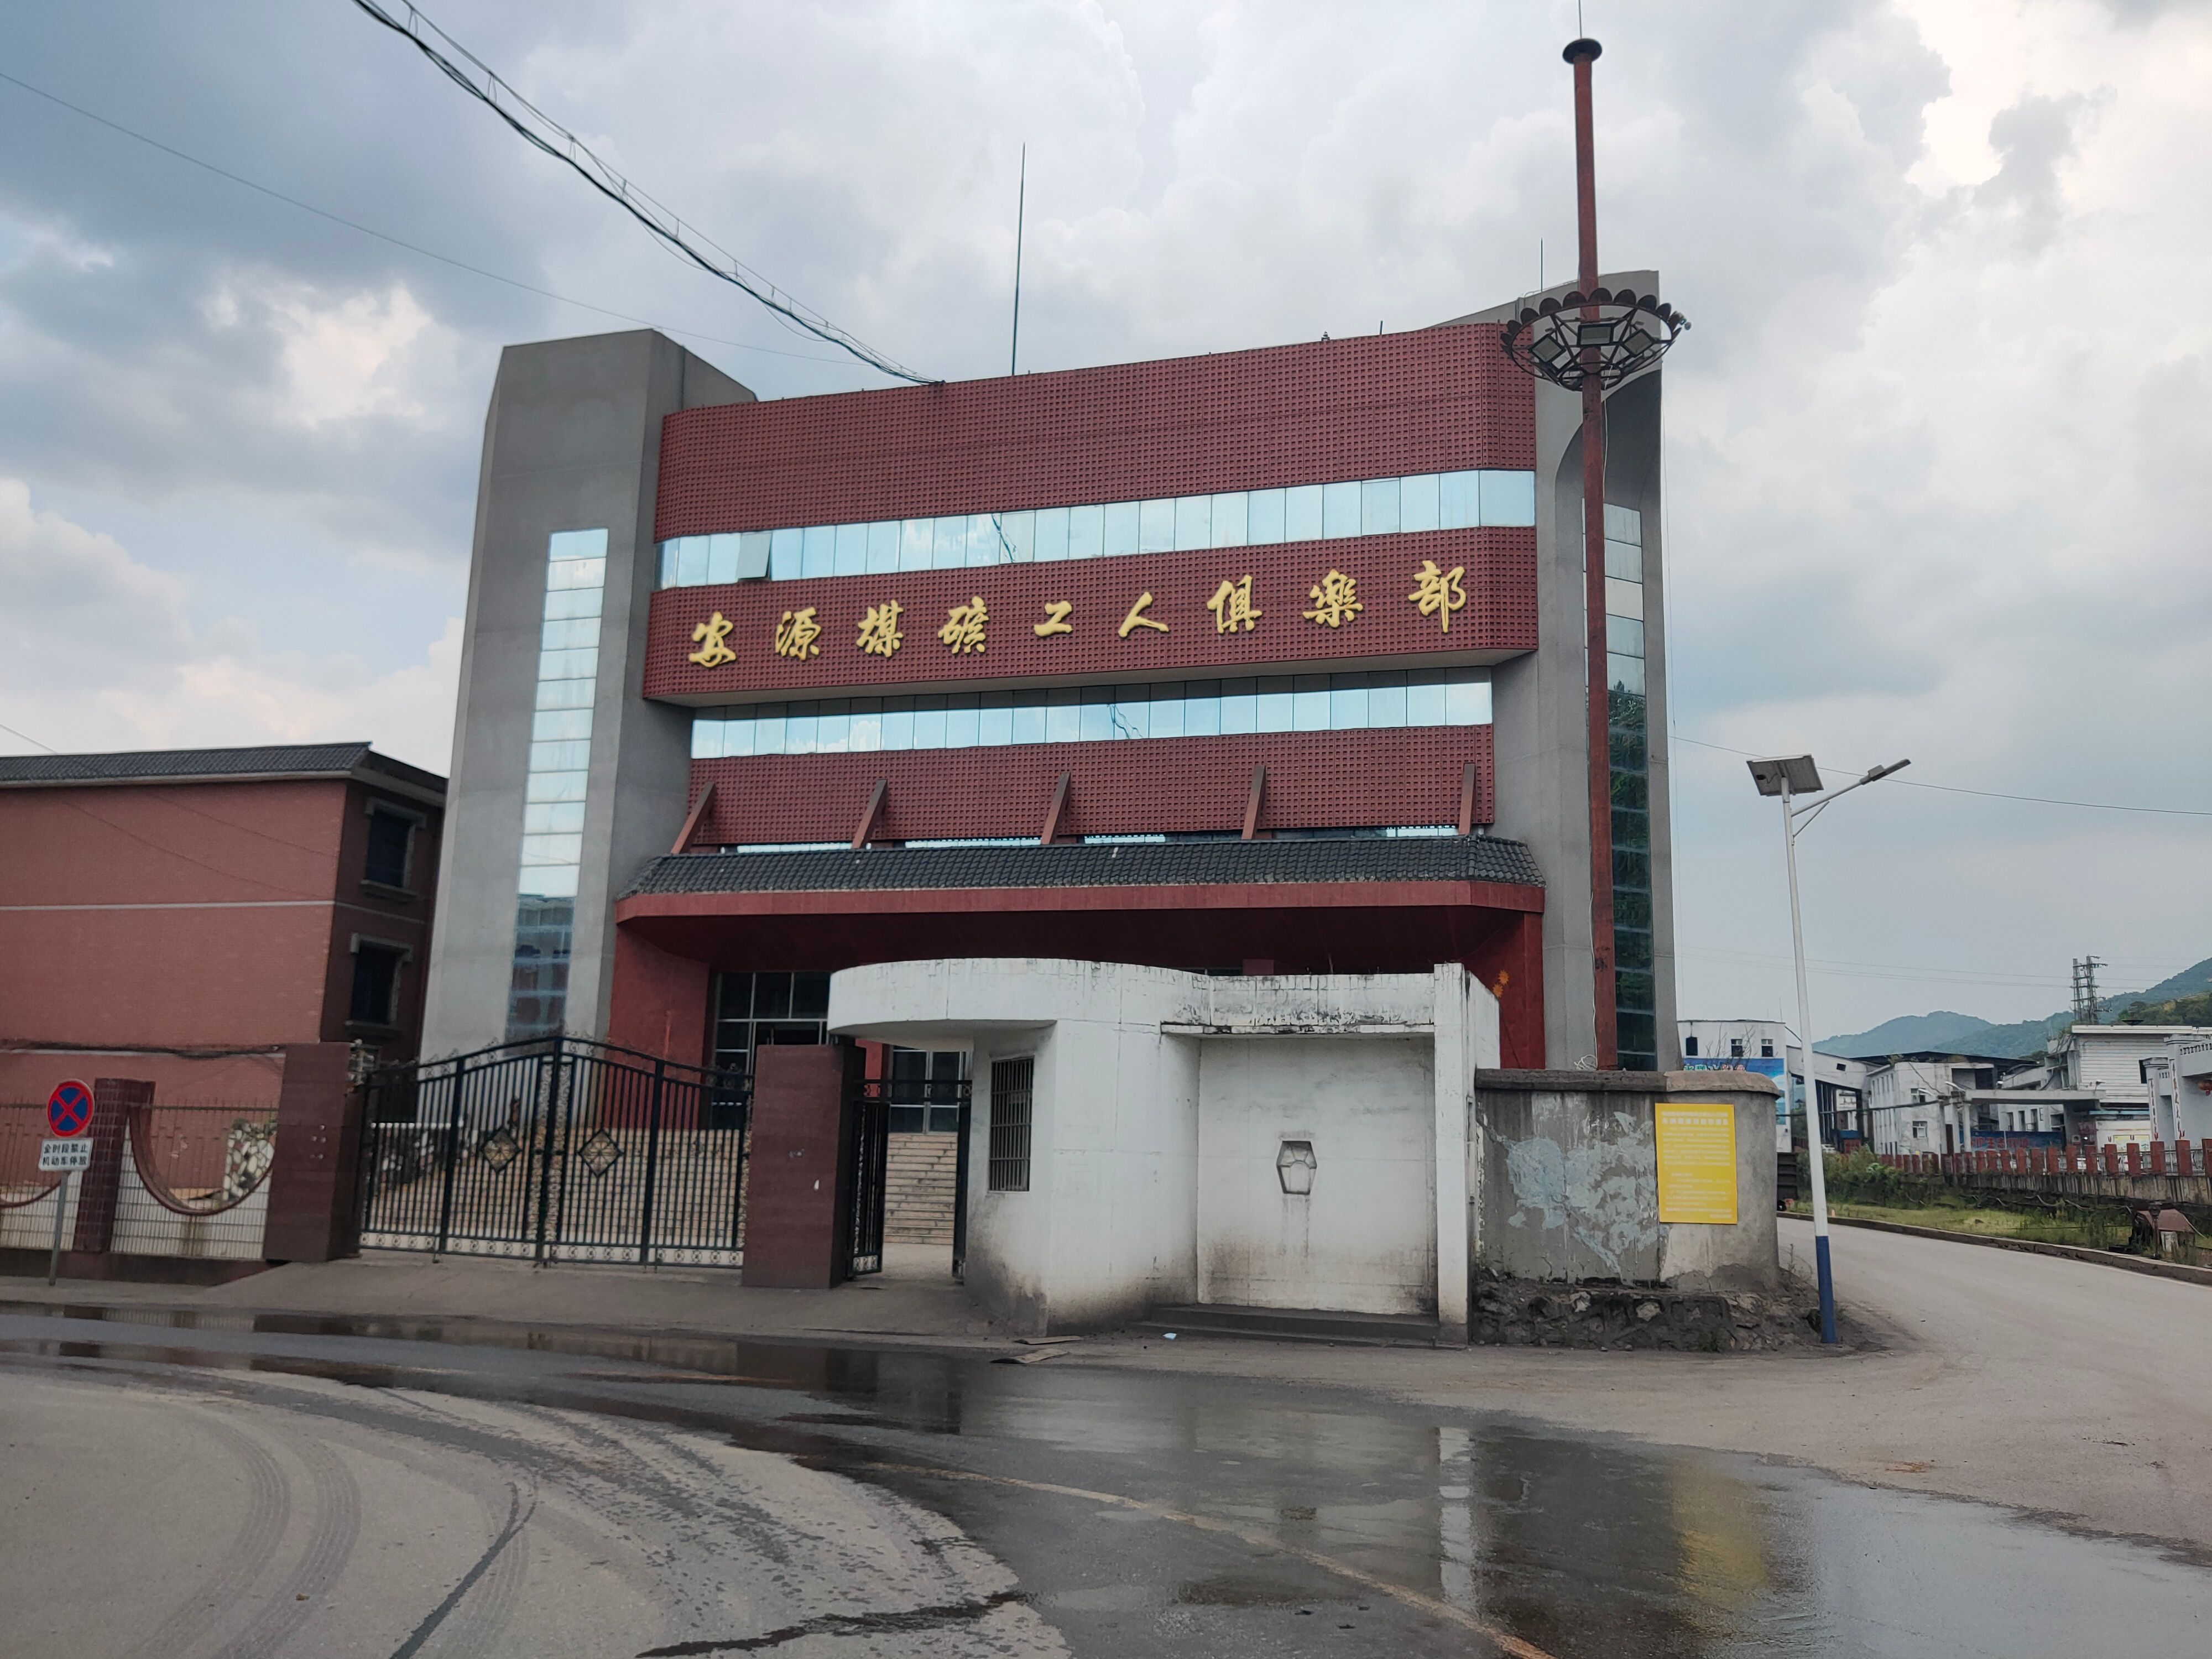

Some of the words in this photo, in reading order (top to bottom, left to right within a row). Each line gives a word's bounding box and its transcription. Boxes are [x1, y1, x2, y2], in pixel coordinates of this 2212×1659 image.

[43, 1156, 87, 1166] 机动车停放
